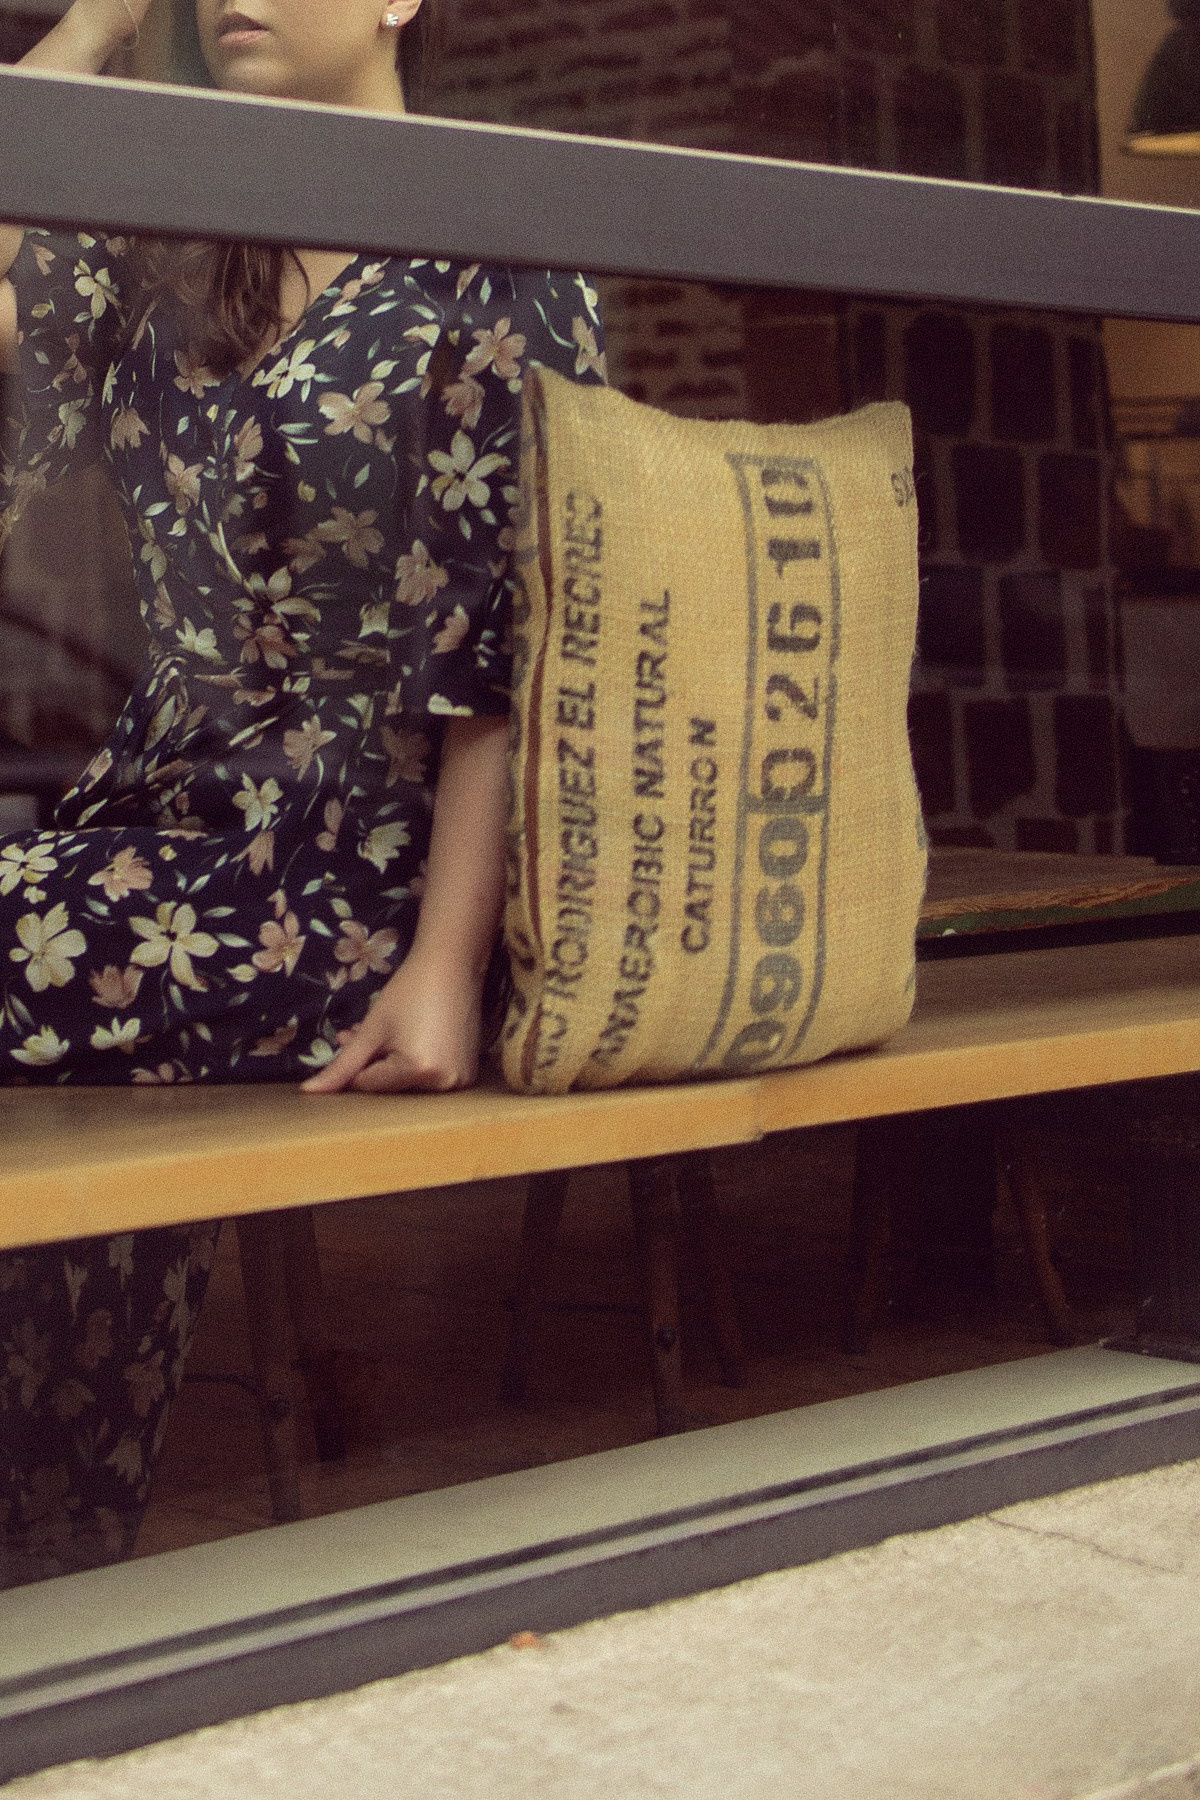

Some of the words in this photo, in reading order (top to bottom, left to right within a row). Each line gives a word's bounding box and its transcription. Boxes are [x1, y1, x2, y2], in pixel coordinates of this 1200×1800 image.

[555, 681, 597, 730] EL
[590, 815, 667, 1069] ANAEROBIC
[632, 590, 674, 800] NATURAL
[543, 736, 599, 1001] RODRIGUEZ
